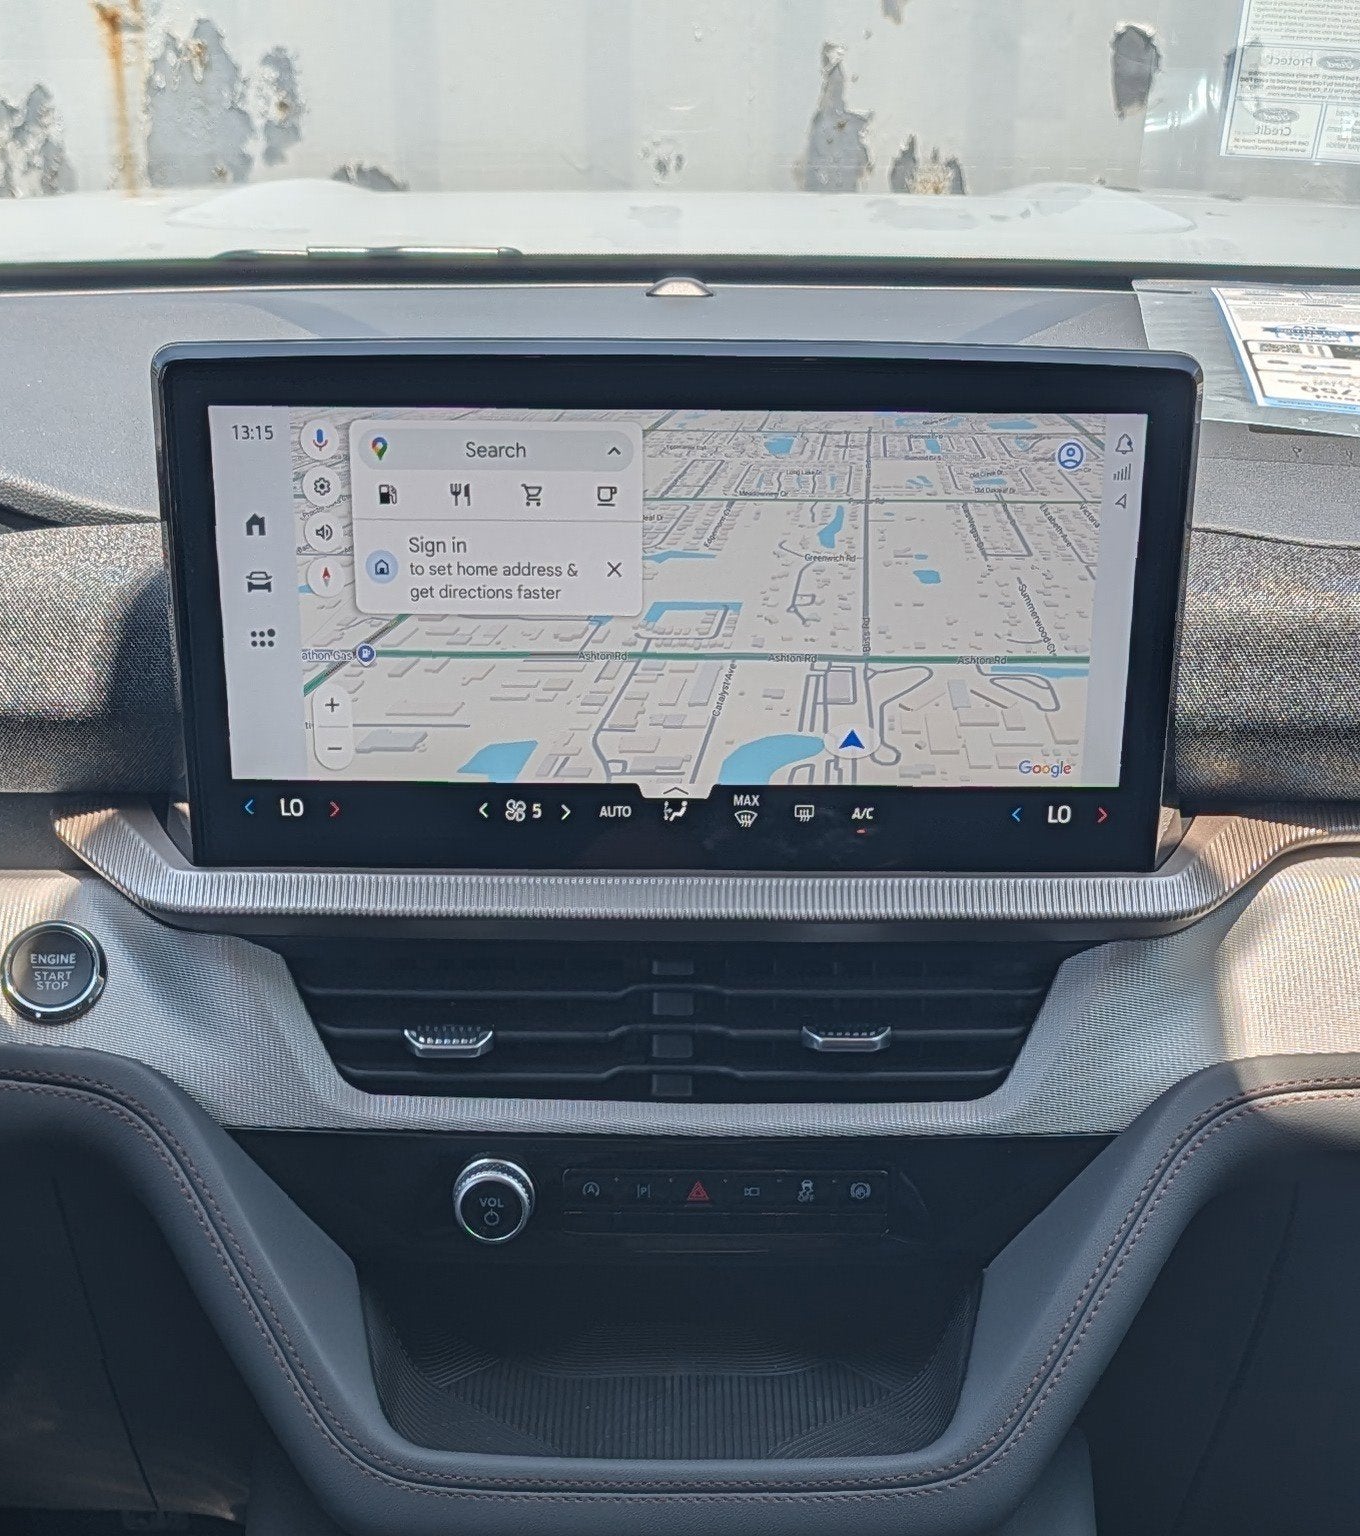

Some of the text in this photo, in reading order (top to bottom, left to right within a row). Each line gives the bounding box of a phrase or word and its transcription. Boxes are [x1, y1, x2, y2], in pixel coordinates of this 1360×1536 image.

[232, 424, 274, 441] 13:15
[465, 441, 527, 459] Search
[408, 536, 467, 557] Sign in
[804, 554, 856, 562] Greenwich Rd
[410, 562, 579, 577] to set home address &
[410, 584, 562, 602] get directions faster
[1018, 584, 1051, 644] Summerwood
[302, 650, 352, 661] athon Gas
[578, 651, 628, 661] Ashton Rd
[768, 654, 818, 662] Ashton Rd
[958, 656, 1008, 664] Ashton Rd
[712, 662, 737, 717] Catalyst Ave
[1018, 760, 1072, 778] Google
[734, 794, 760, 806] MAX
[280, 798, 304, 816] LO
[532, 803, 542, 820] 5
[599, 806, 632, 818] AUTO
[851, 807, 874, 820] A/C
[1048, 805, 1072, 824] LO
[30, 952, 77, 964] ENGINE
[34, 970, 72, 981] START
[36, 980, 69, 990] STOP
[479, 1198, 504, 1208] VOL
